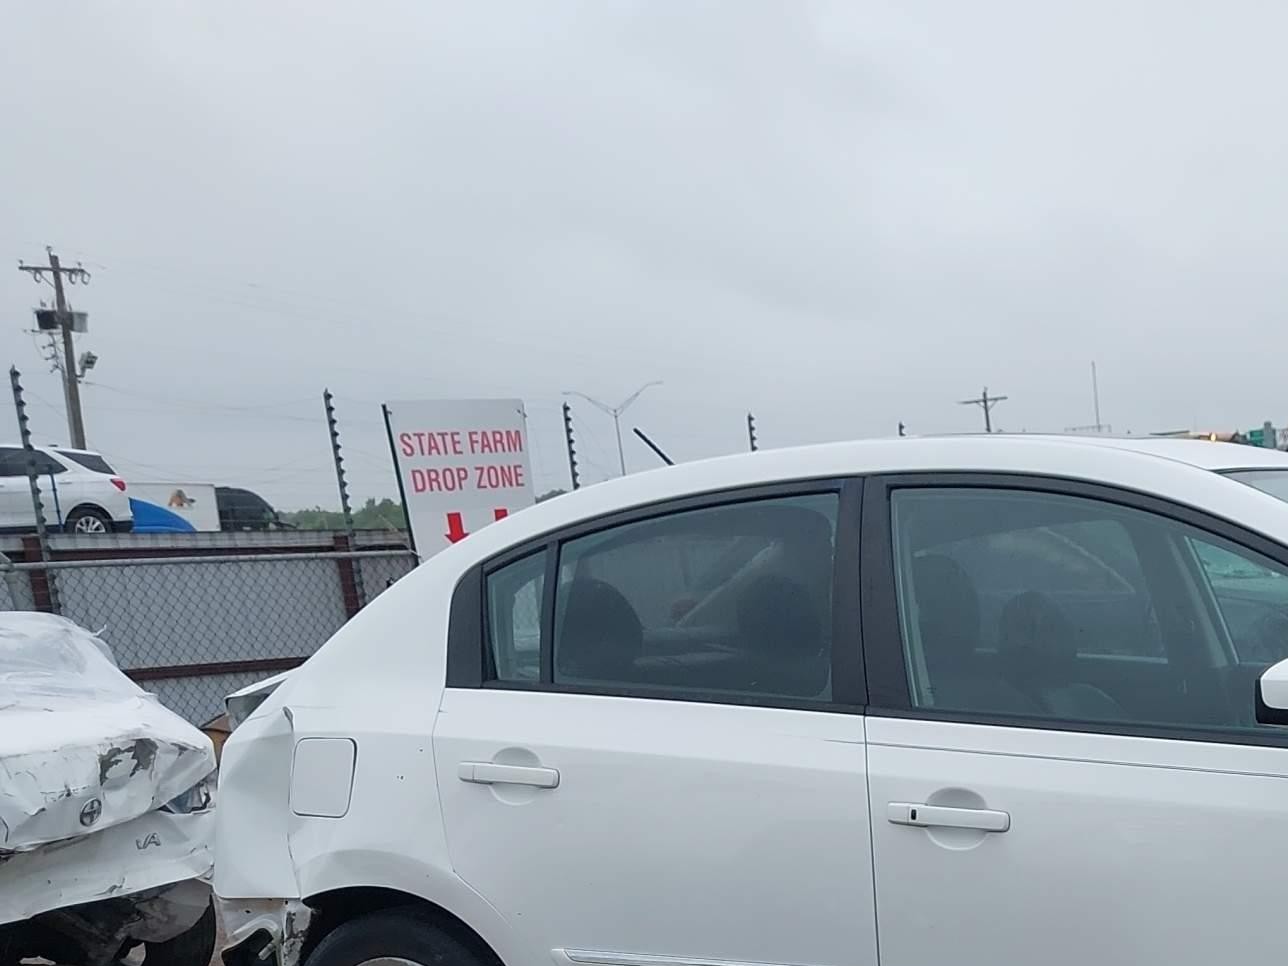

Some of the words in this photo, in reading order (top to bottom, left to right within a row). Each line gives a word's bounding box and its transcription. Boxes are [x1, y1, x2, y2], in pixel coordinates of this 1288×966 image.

[400, 431, 463, 457] STATE
[468, 430, 523, 454] FARM
[411, 467, 468, 493] DROP
[474, 464, 525, 489] ZONE
